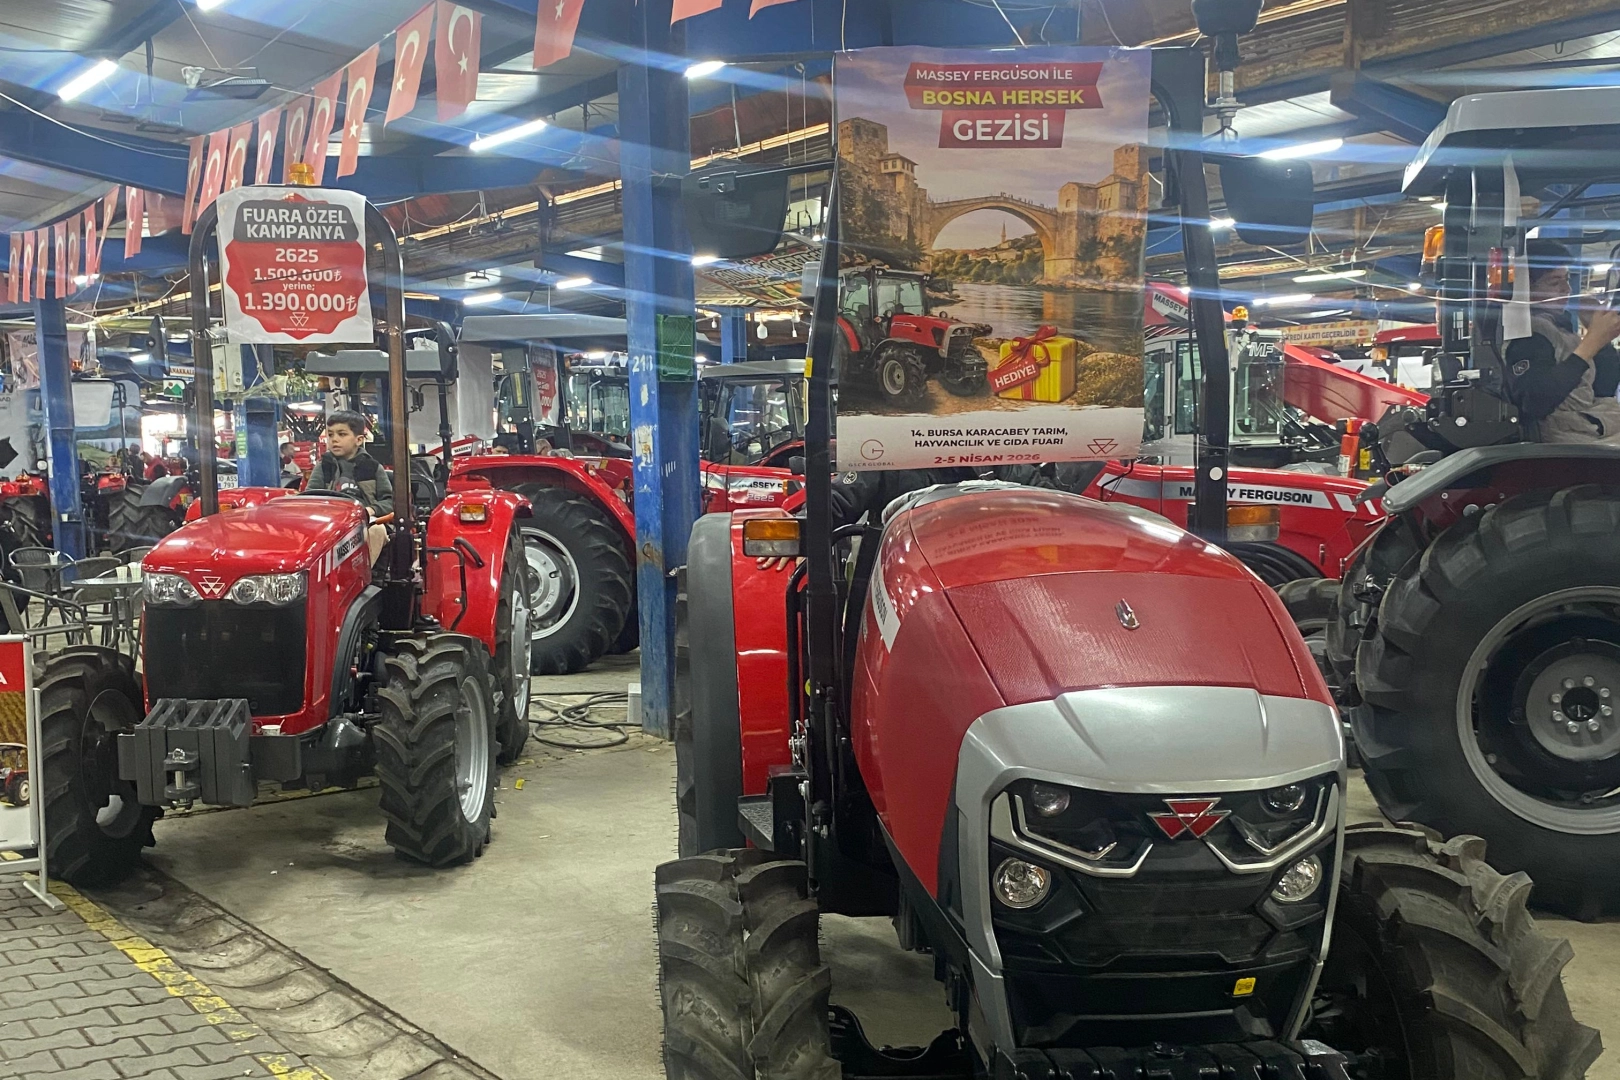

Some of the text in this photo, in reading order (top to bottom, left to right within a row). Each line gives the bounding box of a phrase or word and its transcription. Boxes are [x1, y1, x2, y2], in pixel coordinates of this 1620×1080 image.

[916, 67, 1073, 81] MASSEY FERGUSON İLE
[922, 89, 1084, 106] BOSNA HERSEK
[952, 112, 1049, 141] GEZİSİ
[243, 206, 347, 223] FUARA ÖZEL
[246, 224, 345, 239] KAMPANYA
[275, 248, 319, 263] 2625
[282, 283, 315, 291] yerine;
[244, 292, 357, 312] 1.390.000₺
[1154, 293, 1183, 312] MASSEY
[1303, 332, 1320, 340] KARTI
[1321, 329, 1356, 339] GEÇERLİDİR
[1249, 342, 1274, 357] MF
[911, 428, 1068, 437] 14. BURSA KARACABEY TARIM,
[914, 439, 984, 447] HAYVANCILIK
[1003, 438, 1030, 446] GIDA
[934, 456, 955, 464] 2-5
[959, 453, 1003, 463] NİSAN
[1239, 488, 1313, 504] FERGUSON
